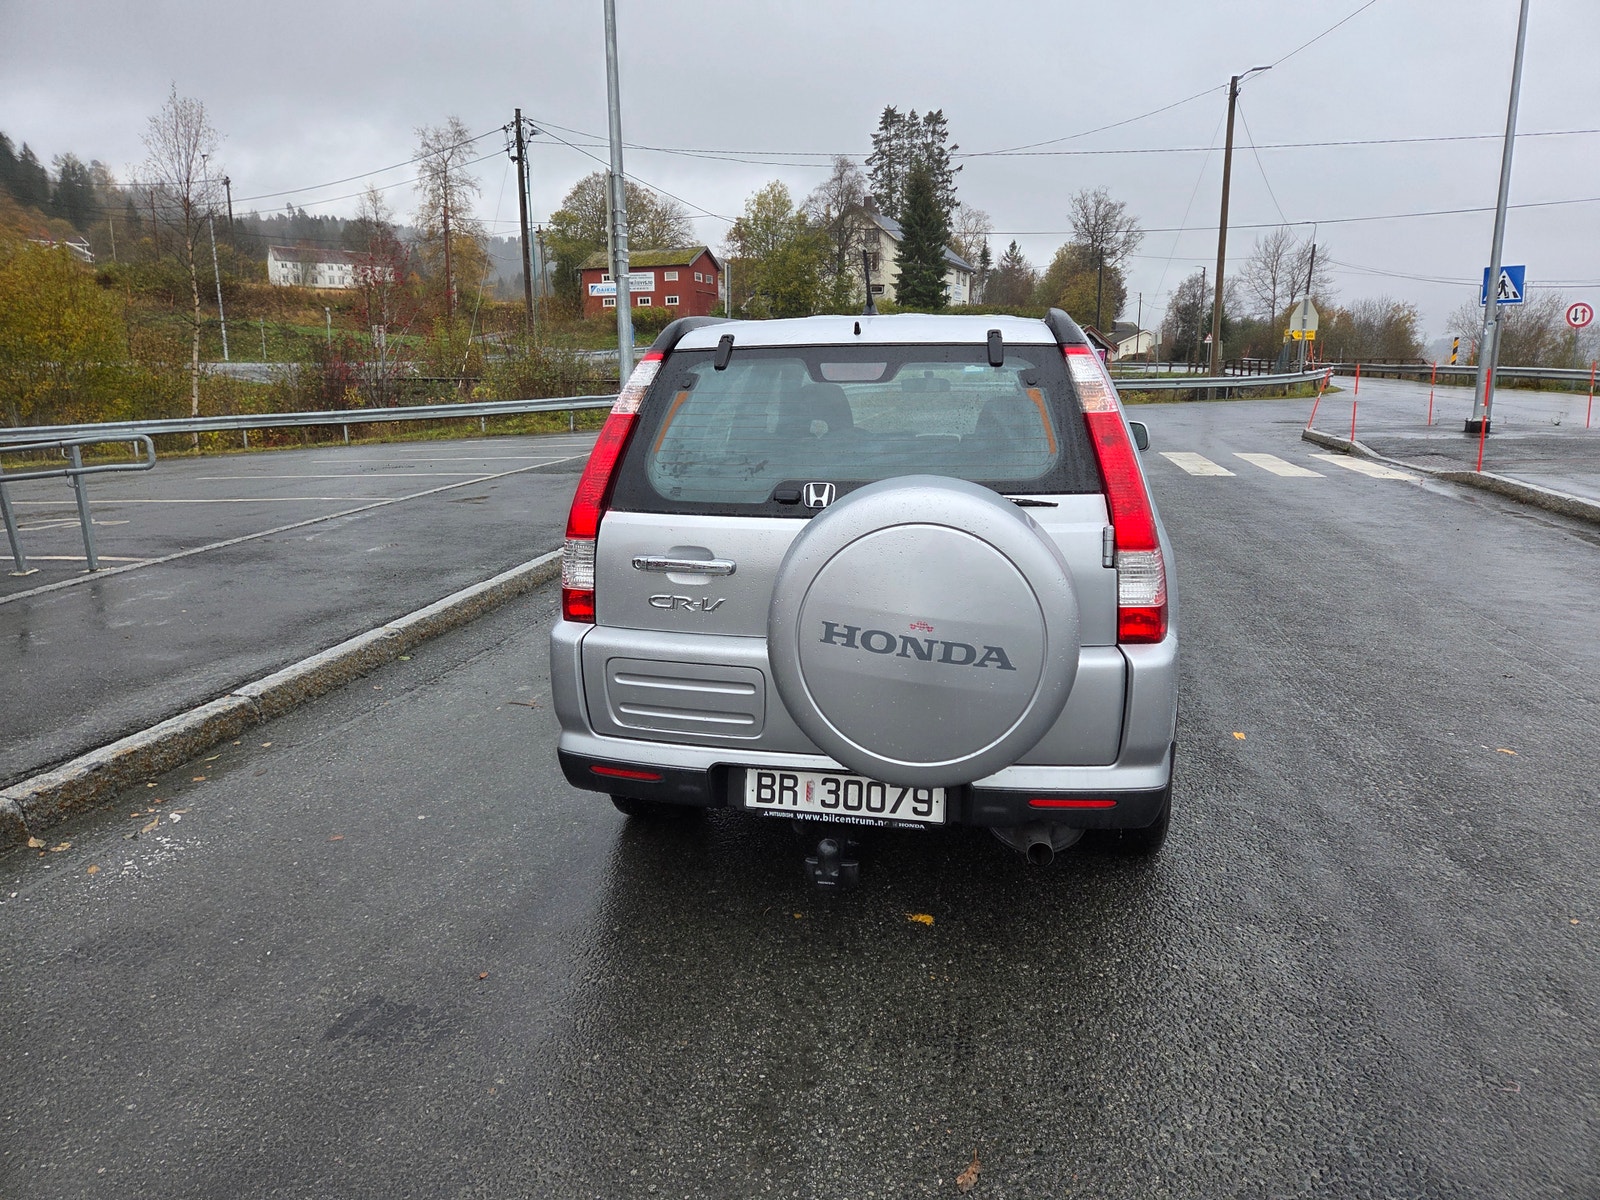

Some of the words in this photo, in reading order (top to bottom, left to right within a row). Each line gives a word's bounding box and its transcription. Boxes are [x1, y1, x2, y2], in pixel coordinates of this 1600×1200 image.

[648, 594, 727, 612] CR-V
[819, 621, 1017, 671] HONDA
[756, 772, 799, 806] BR
[820, 777, 934, 817] 30079
[898, 822, 926, 830] HONDA
